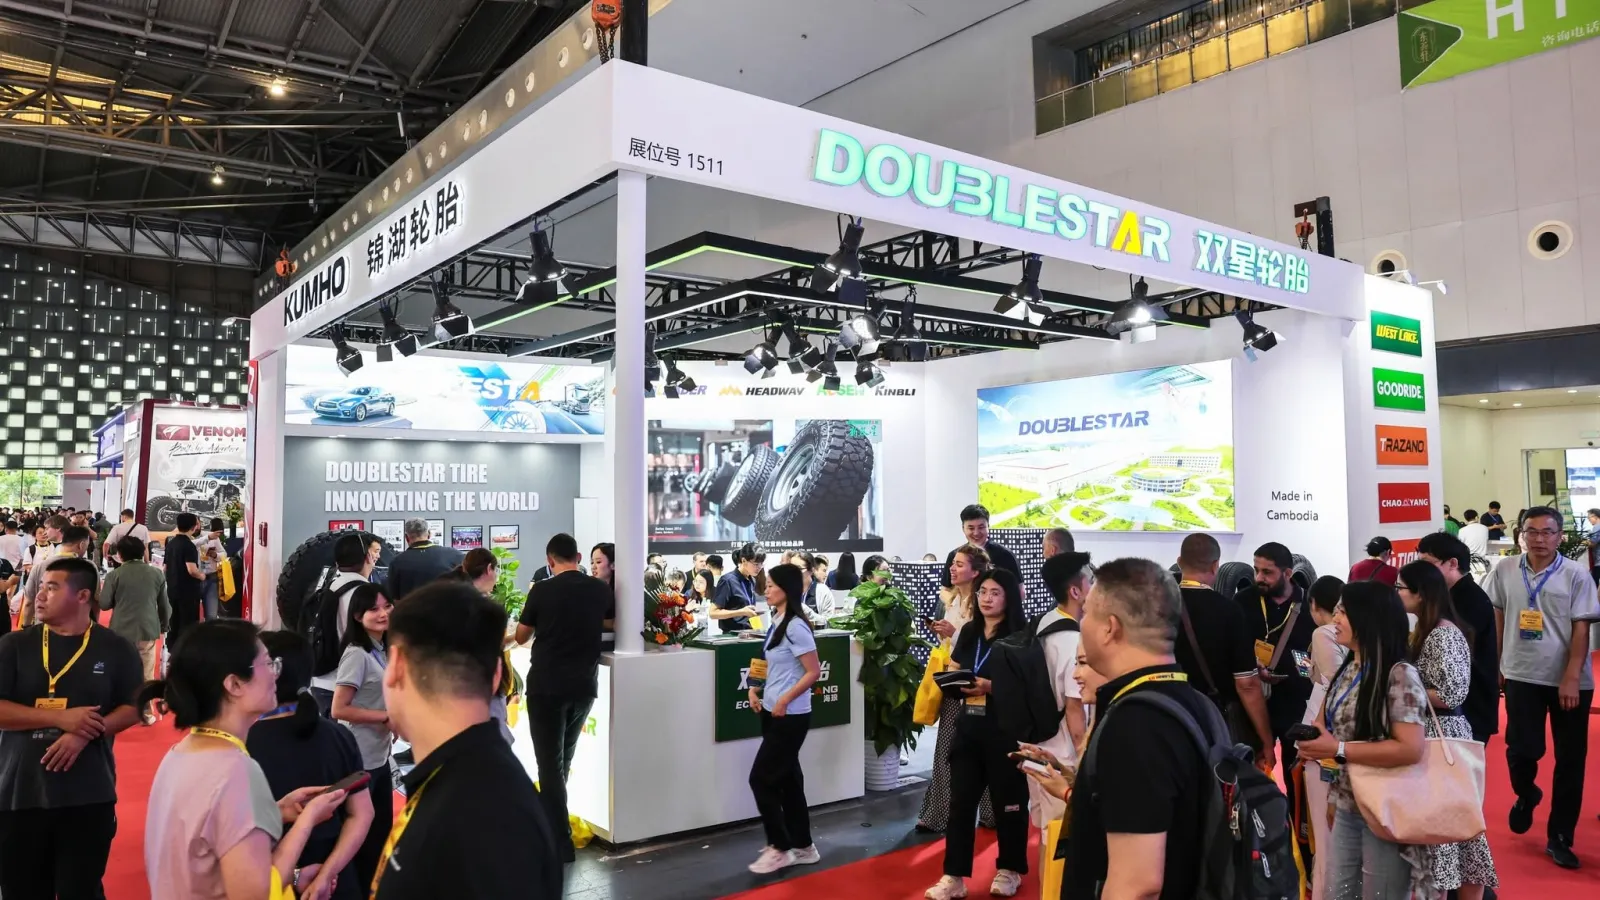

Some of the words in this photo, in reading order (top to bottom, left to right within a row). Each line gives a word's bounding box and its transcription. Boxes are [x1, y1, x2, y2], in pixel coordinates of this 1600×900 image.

[1541, 20, 1600, 47] 咨询电话
[628, 137, 682, 167] 展位号
[688, 152, 723, 176] 1511
[814, 127, 1172, 263] DOUBLESTAR
[366, 181, 460, 278] 锦湖轮胎
[1195, 228, 1311, 295] 双星轮胎
[283, 255, 347, 327] KUMHO
[1376, 324, 1399, 340] WEST
[745, 387, 805, 396] HEADWAY
[192, 425, 247, 438] VENOM
[1018, 410, 1150, 436] DOUBLESTAR
[1380, 437, 1425, 453] TRAZANO
[325, 461, 446, 483] DOUBLESTAR
[450, 463, 488, 484] TIRE
[325, 490, 439, 512] INNOVATING
[443, 491, 476, 511] THE
[479, 492, 540, 511] WORLD
[1271, 491, 1300, 502] Made
[1303, 491, 1313, 501] in
[1266, 509, 1319, 522] Cambodia
